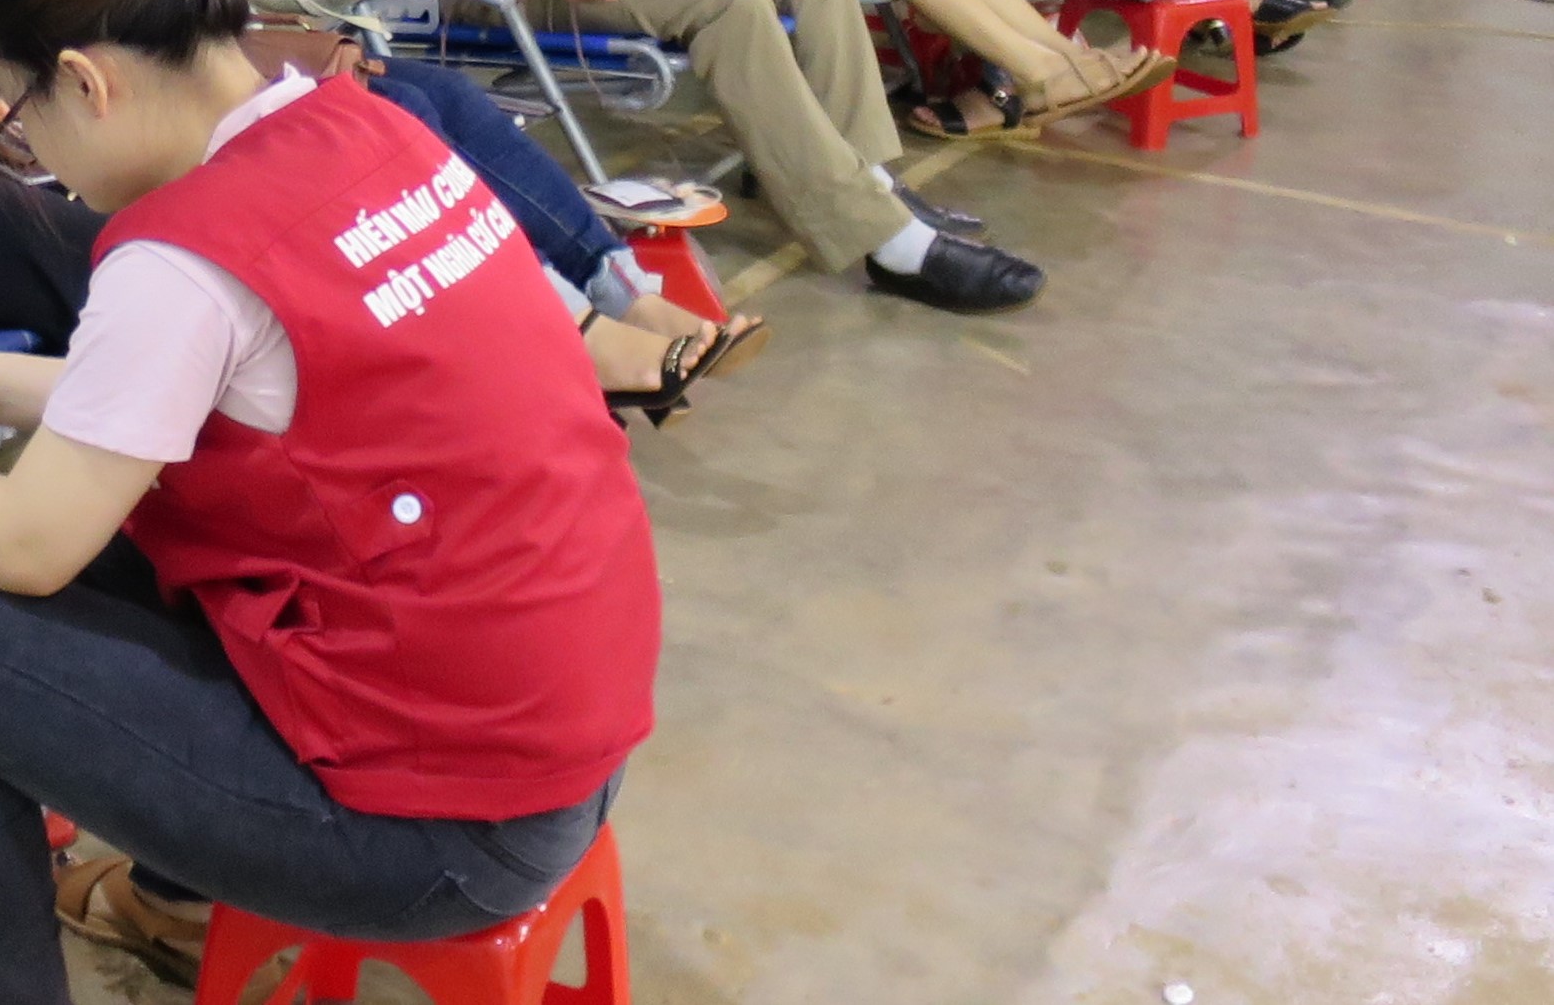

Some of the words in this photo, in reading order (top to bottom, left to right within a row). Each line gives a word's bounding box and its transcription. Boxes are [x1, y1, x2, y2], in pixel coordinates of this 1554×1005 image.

[334, 209, 408, 269] HIẾN
[389, 185, 442, 235] MÁU
[363, 264, 435, 328] MỘT
